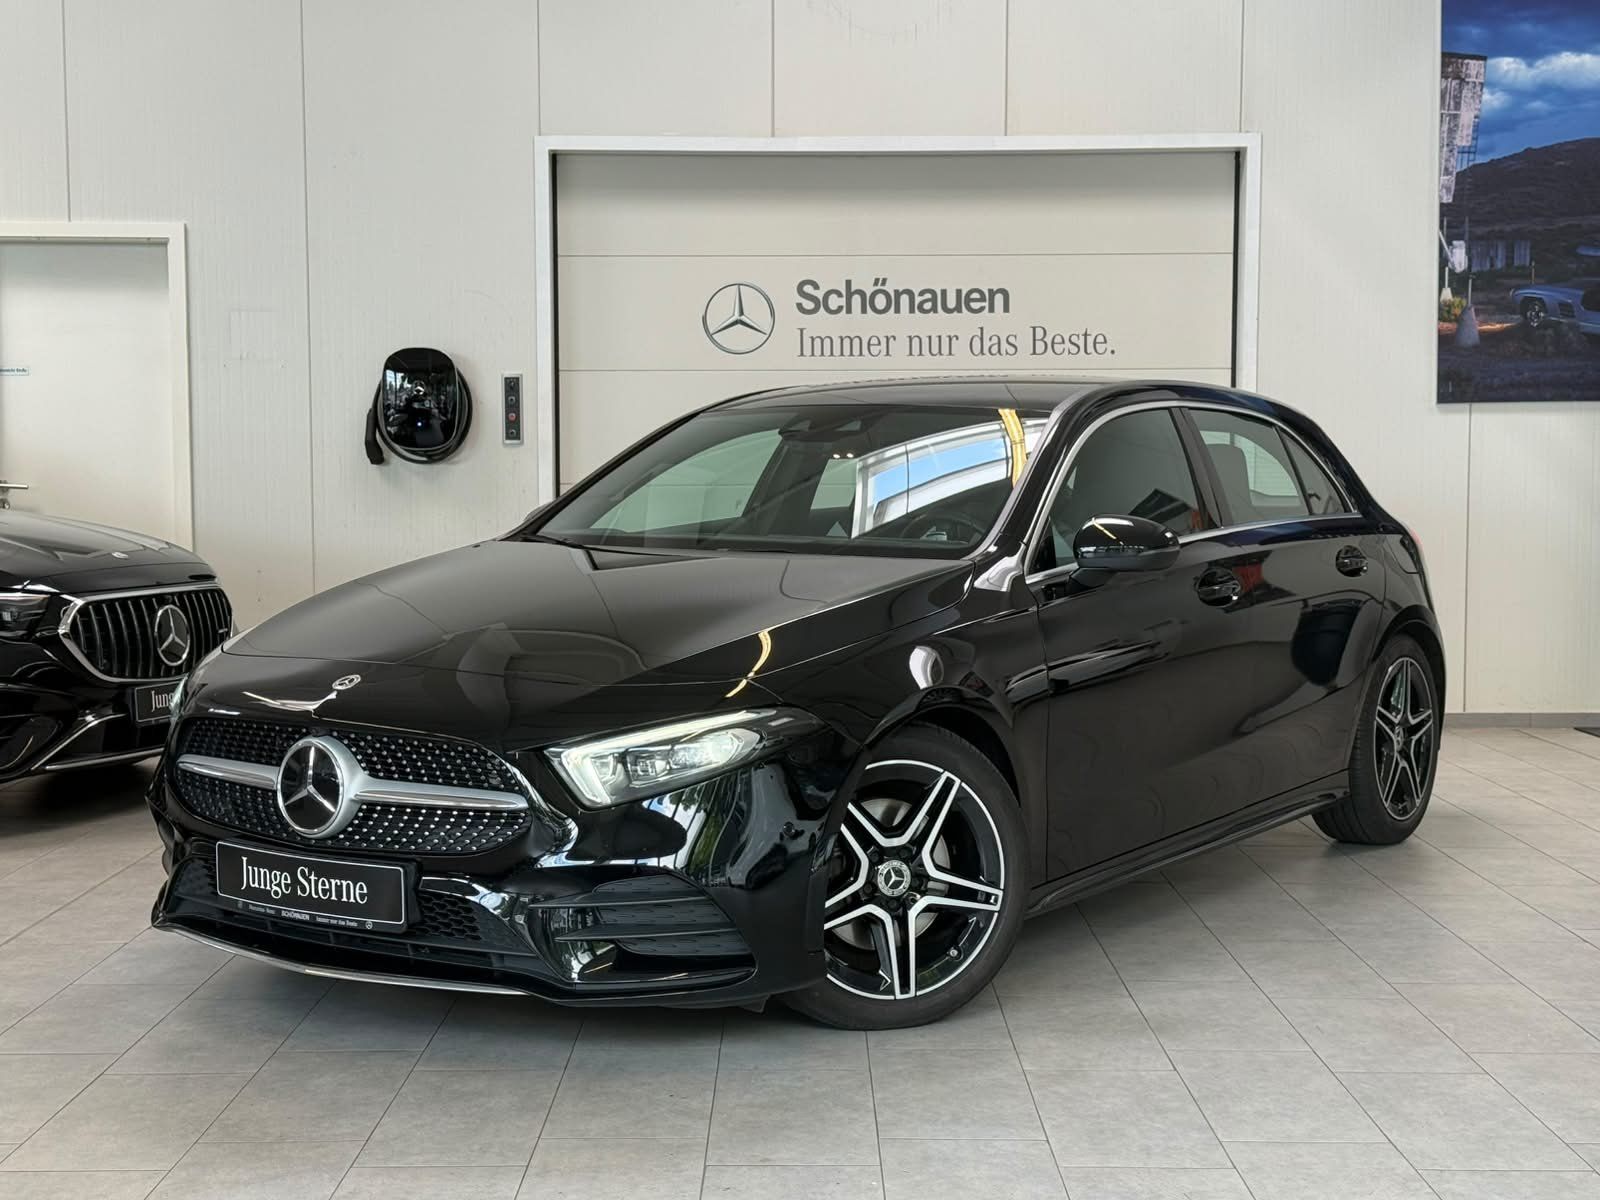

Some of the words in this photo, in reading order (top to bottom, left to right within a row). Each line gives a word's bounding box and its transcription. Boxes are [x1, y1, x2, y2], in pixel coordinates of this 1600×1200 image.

[797, 327, 897, 358] Immer
[907, 334, 960, 357] nur
[969, 326, 1018, 357] das
[1029, 325, 1116, 356] Beste.
[241, 856, 291, 899] Junge
[297, 866, 368, 904] Sterne
